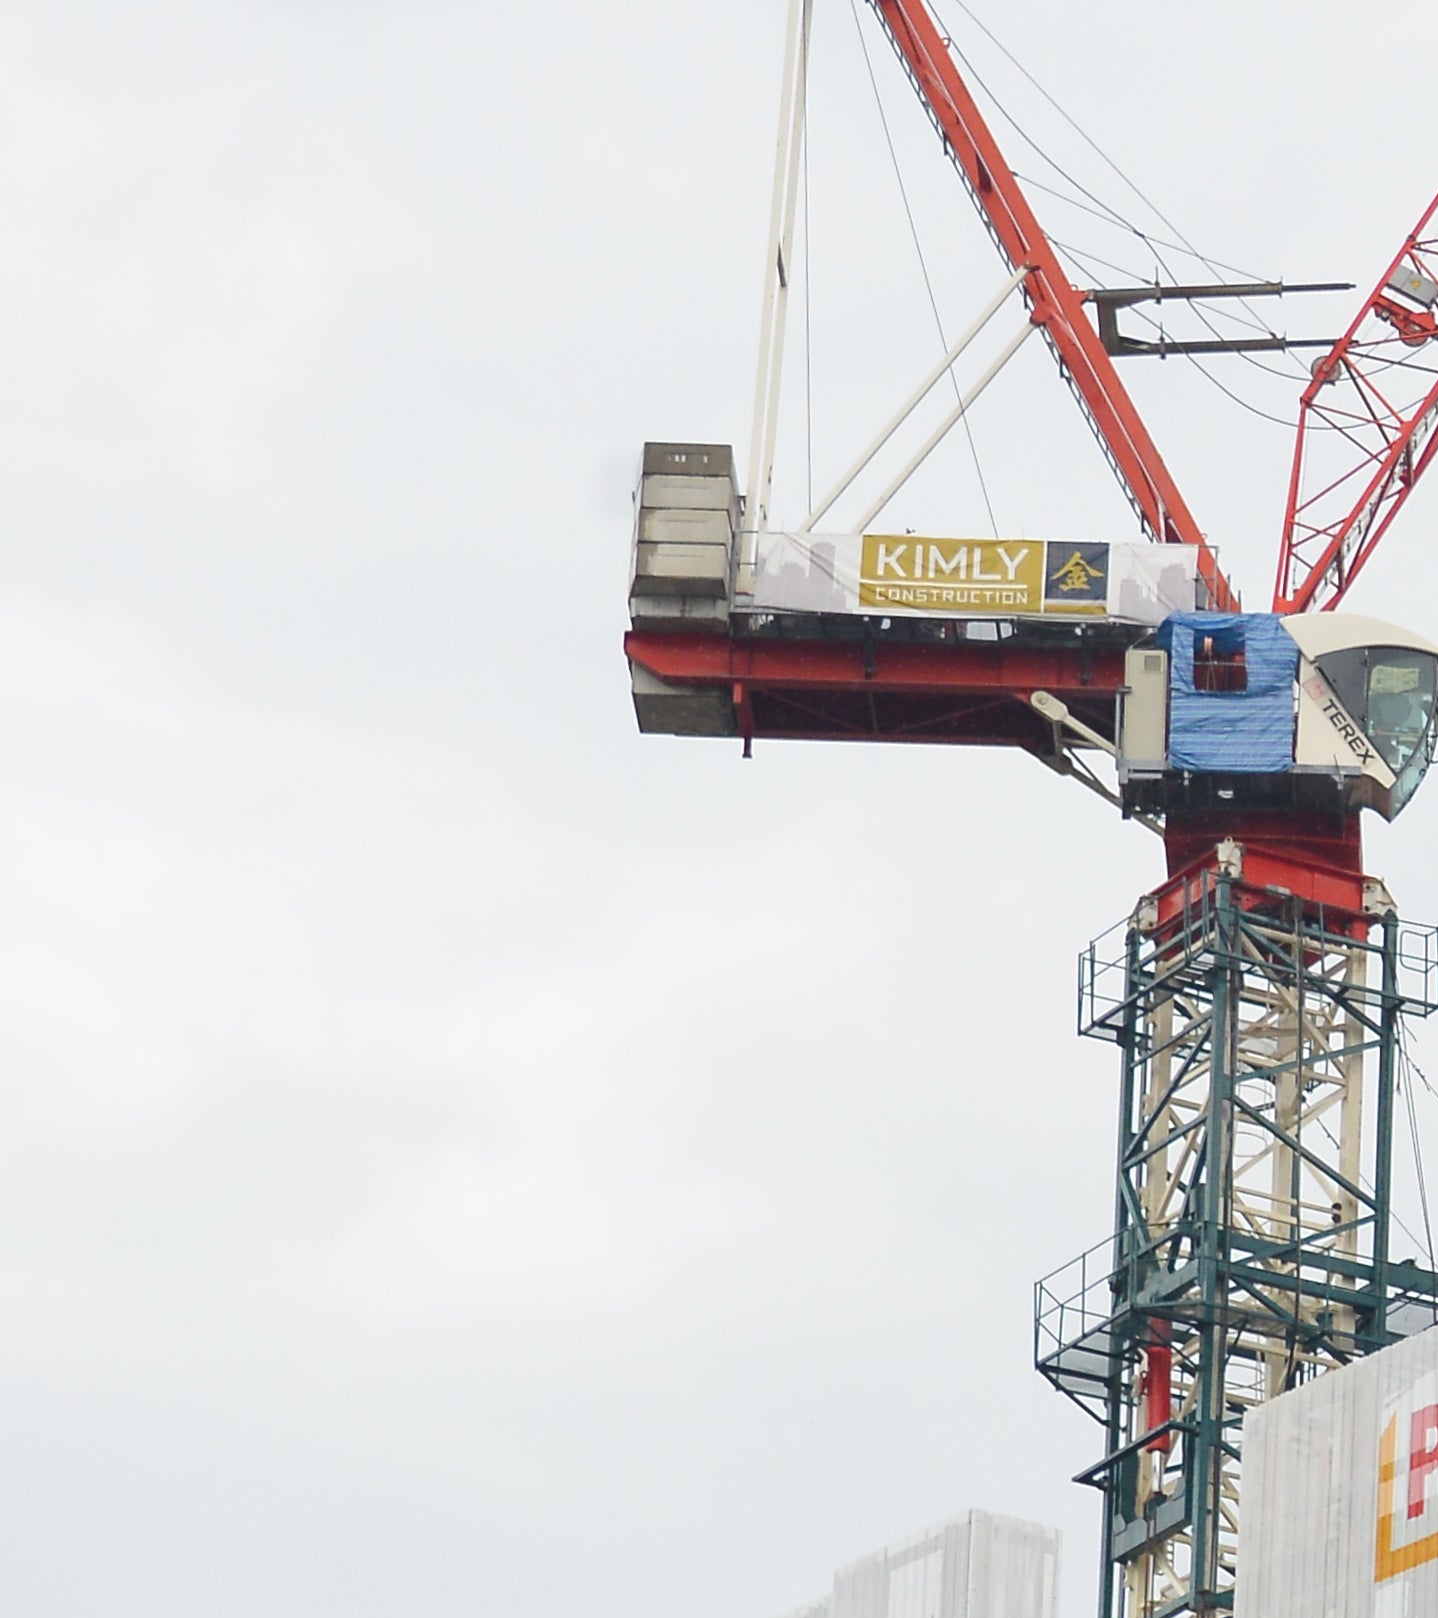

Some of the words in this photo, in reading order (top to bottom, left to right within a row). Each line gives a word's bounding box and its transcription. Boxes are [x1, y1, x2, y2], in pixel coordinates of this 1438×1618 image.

[876, 543, 1029, 581] KIMLY
[1051, 551, 1104, 592] 金
[875, 587, 1028, 605] CONSTRUCTION
[1322, 699, 1376, 765] TEREX
